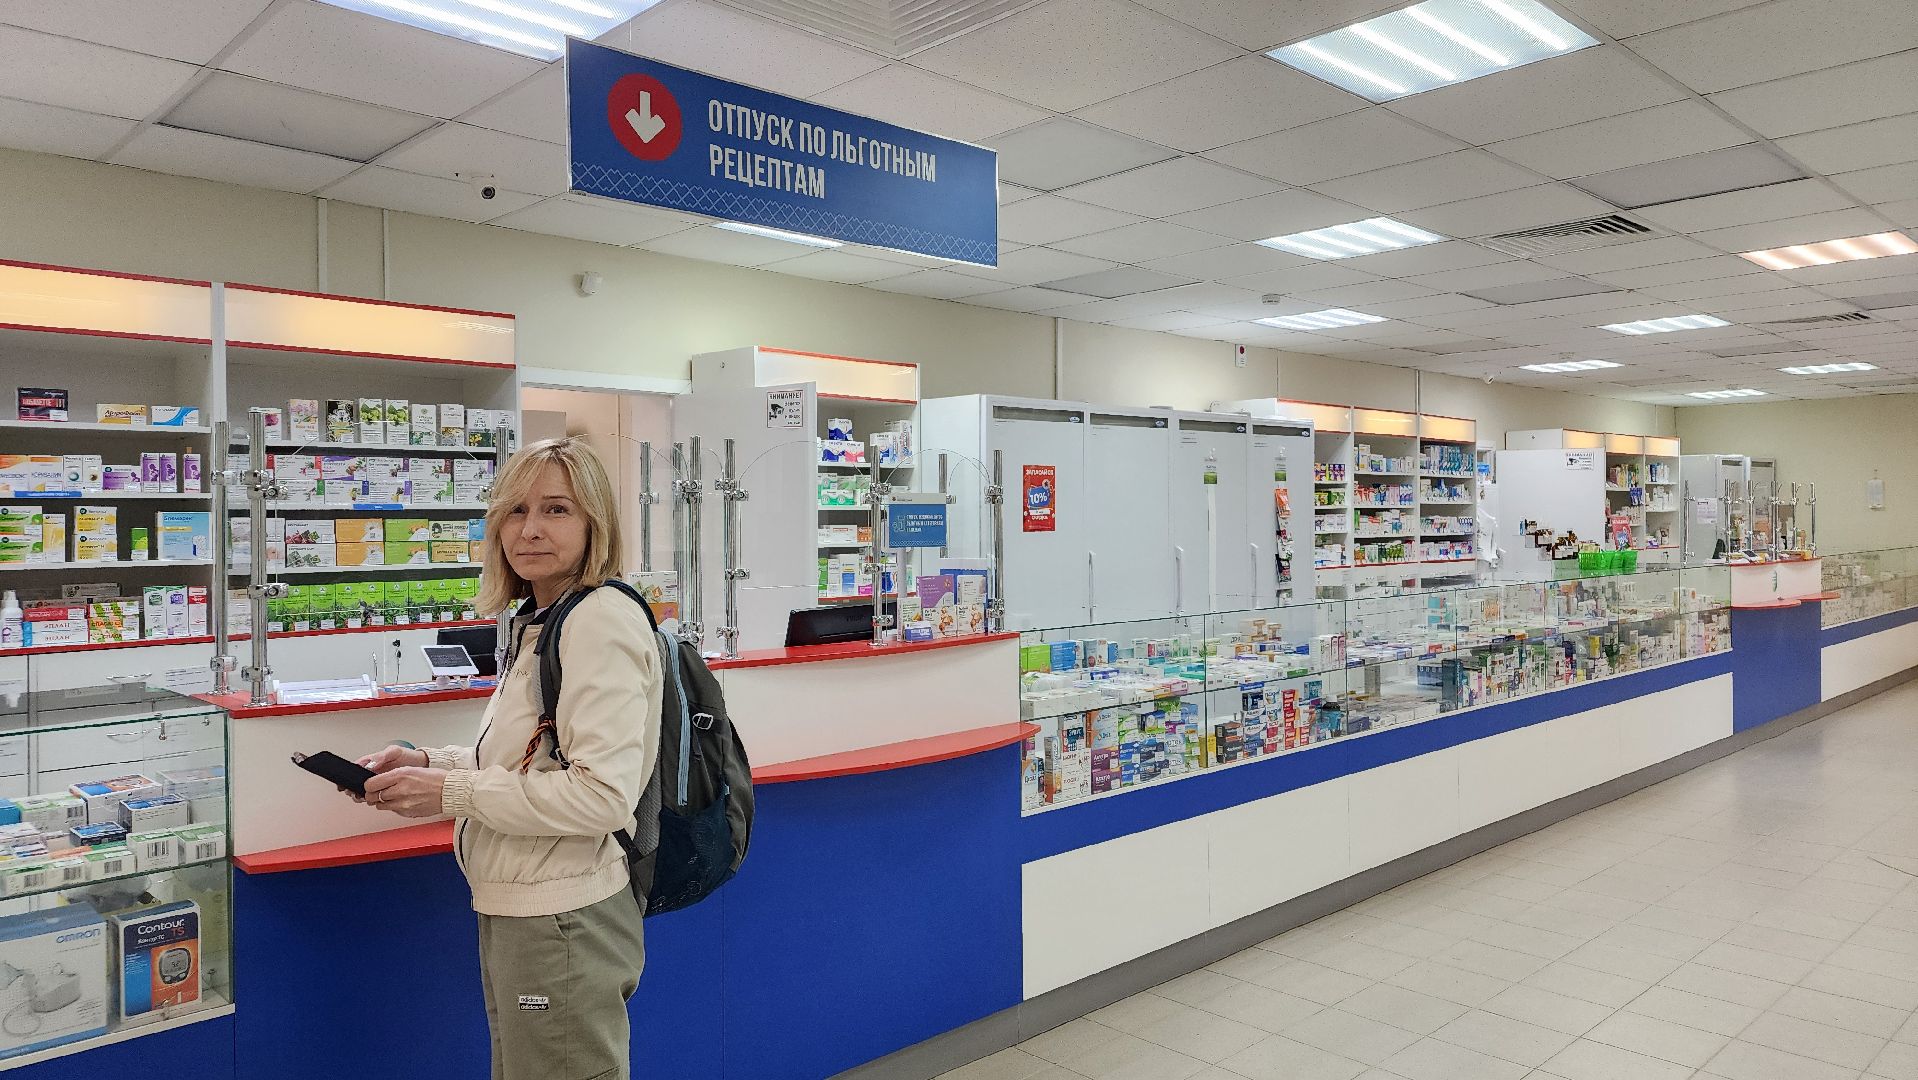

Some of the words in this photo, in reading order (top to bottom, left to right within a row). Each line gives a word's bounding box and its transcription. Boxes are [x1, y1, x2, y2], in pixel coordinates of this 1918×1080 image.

[709, 99, 794, 152] ОТПУСК
[799, 121, 827, 157] ПО
[831, 131, 936, 182] ЛЬГОТНЫМ
[709, 143, 826, 199] РЕЦЕПТАМ
[1029, 492, 1048, 505] 10%
[137, 918, 185, 935] Contour
[170, 927, 185, 937] TS
